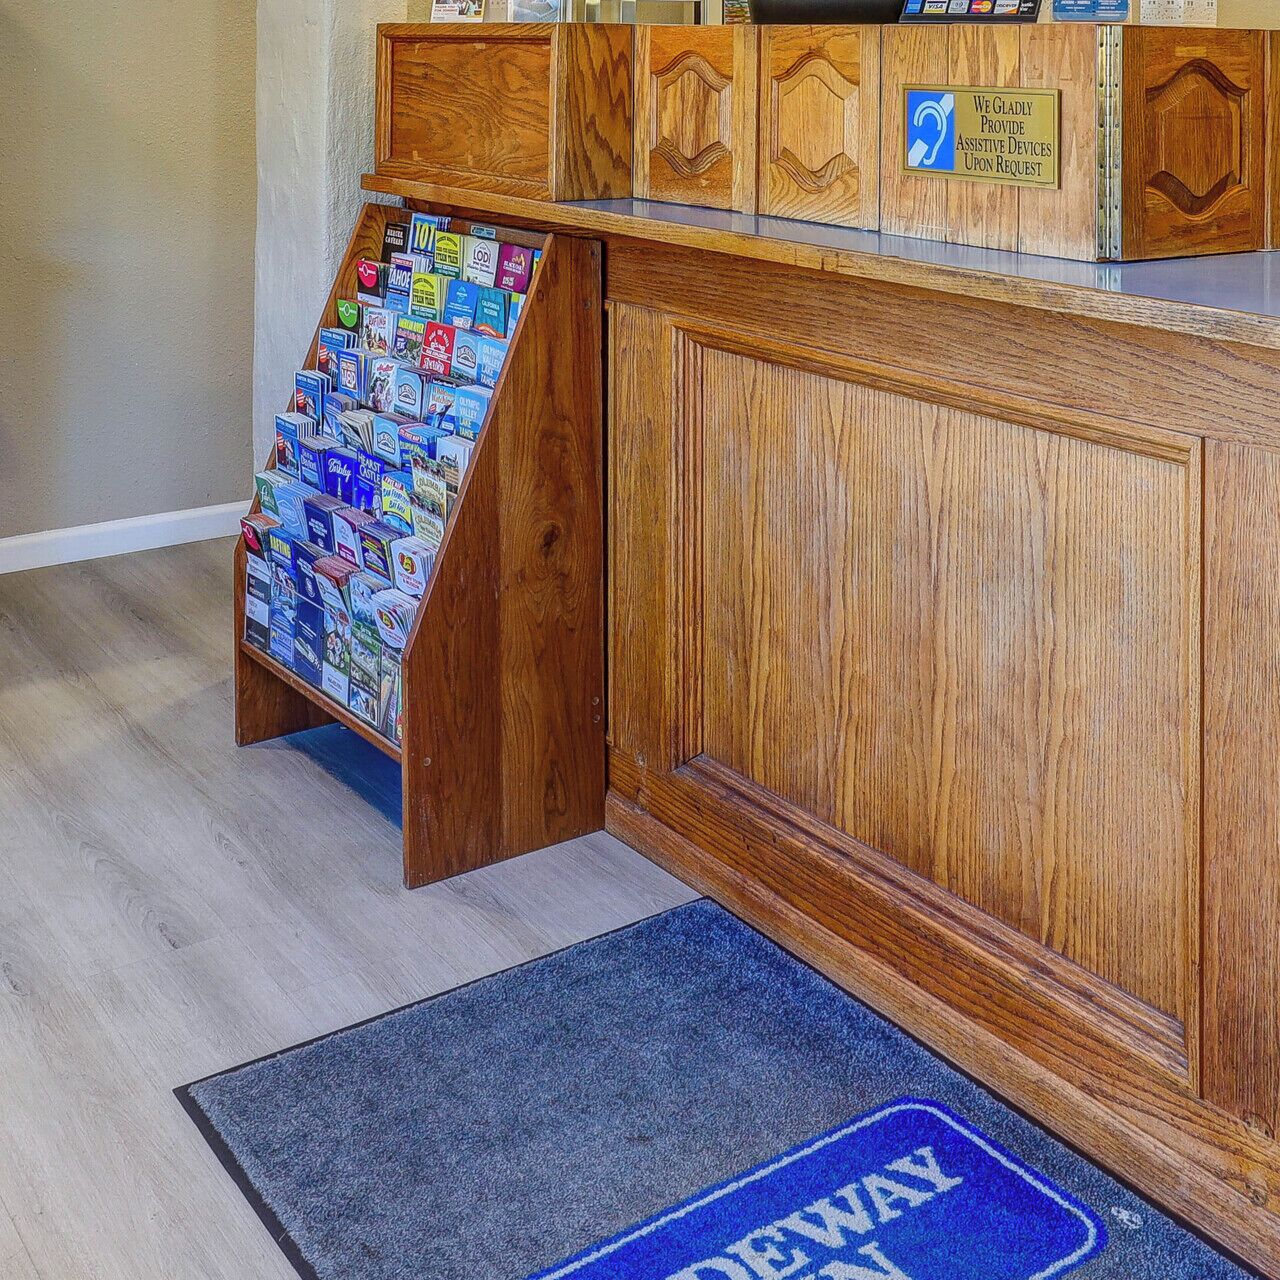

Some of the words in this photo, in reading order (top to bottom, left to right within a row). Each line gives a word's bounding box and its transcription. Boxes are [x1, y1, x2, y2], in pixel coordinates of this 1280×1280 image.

[415, 221, 435, 251] 101
[473, 248, 491, 265] LODI
[388, 268, 412, 288] TAHOE
[460, 407, 477, 419] VALLEY
[460, 417, 471, 428] LAKE
[359, 452, 382, 473] HEARST
[359, 464, 380, 484] CASTLE
